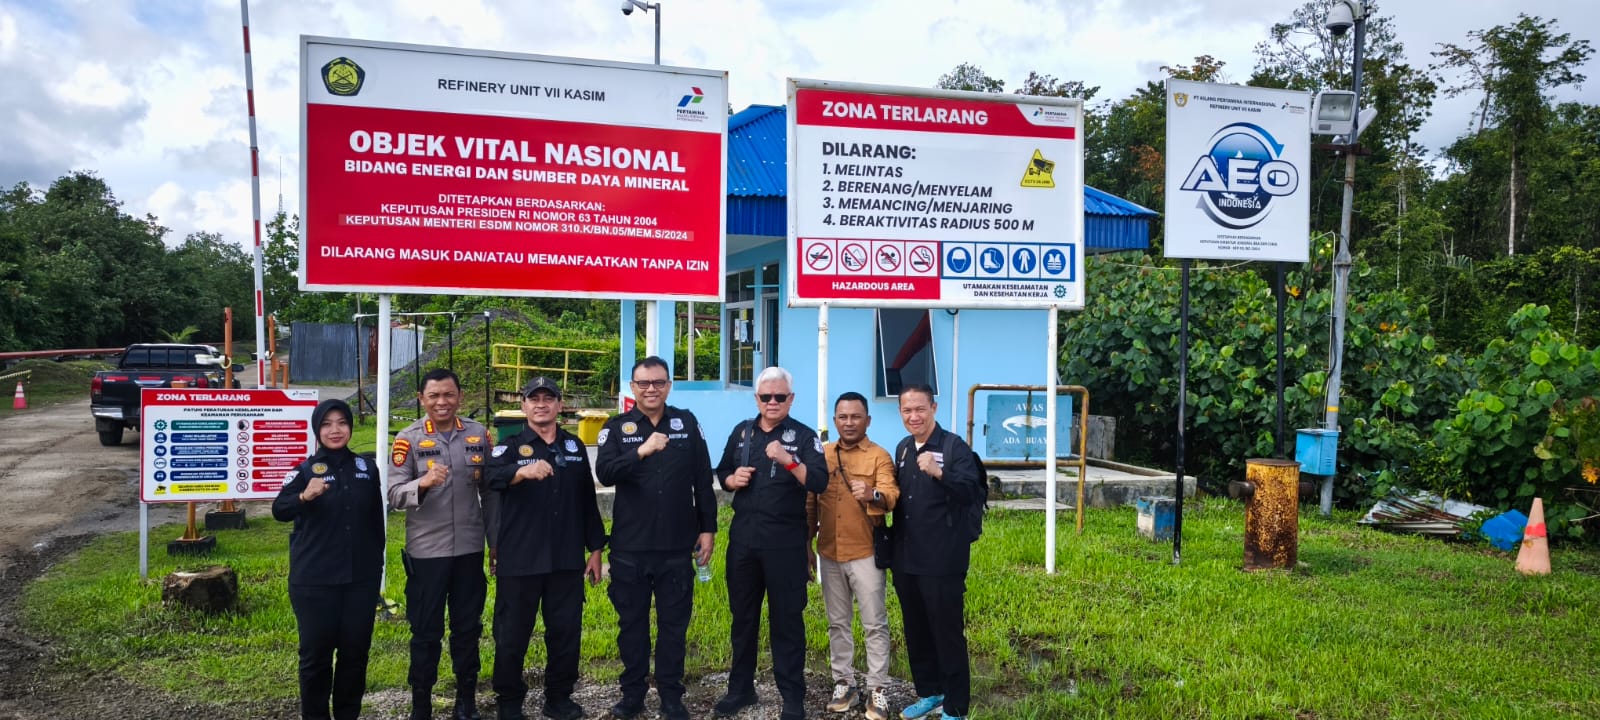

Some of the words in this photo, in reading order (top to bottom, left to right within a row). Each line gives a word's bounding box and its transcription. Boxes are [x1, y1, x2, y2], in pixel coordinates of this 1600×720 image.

[438, 78, 506, 94] REFINERY
[510, 84, 541, 96] UNIT
[544, 87, 560, 98] VII
[564, 89, 606, 102] KASIM
[822, 101, 877, 120] ZONA
[880, 104, 989, 126] TERLARANG
[349, 130, 447, 158] OBJEK
[455, 136, 537, 163] VITAL
[544, 142, 687, 173] NASIONAL
[822, 141, 917, 160] DILARANG:
[344, 159, 408, 175] BIDANG
[411, 163, 471, 178] ENERGI
[475, 167, 509, 181] DAN
[512, 169, 577, 185] SUMBER
[581, 173, 621, 187] DAYA
[624, 177, 690, 192] MINERAL
[822, 163, 832, 175] 1.
[834, 164, 903, 178] MELINTAS
[1180, 155, 1299, 197] AEO
[822, 179, 835, 192] 2.
[837, 180, 993, 198] BERENANG/MENYELAM
[438, 193, 513, 207] DITETAPKAN
[515, 197, 606, 212] BERDASARKAN:
[822, 197, 835, 209] 3.
[838, 198, 1013, 214] MEMANCING/MENJARING
[1218, 198, 1262, 209] INDONESIA
[381, 203, 454, 216] KEPUTUSAN
[457, 207, 516, 219] PRESIDEN
[518, 209, 531, 219] RI
[533, 211, 576, 222] NOMOR
[578, 213, 591, 223] 63
[593, 214, 632, 225] TAHUN
[633, 216, 658, 226] 2004
[822, 213, 836, 226] 4.
[839, 214, 938, 229] BERAKTIVITAS
[940, 218, 991, 230] RADIUS
[994, 219, 1020, 231] 500
[1022, 220, 1035, 231] M
[345, 215, 420, 227] KEPUTUSAN
[423, 217, 476, 229] MENTERI
[479, 219, 513, 231] ESDM
[515, 221, 559, 232] NOMOR
[561, 223, 688, 241] 310.K/BN.05/MEM.S/2024
[320, 245, 396, 259] DILARANG
[399, 248, 450, 262] MASUK
[453, 250, 524, 264] DAN/ATAU
[527, 253, 639, 269] MEMANFAATKAN
[641, 257, 683, 270] TANPA
[686, 260, 709, 272] IZIN
[832, 281, 890, 291] HAZARDOUS
[890, 282, 915, 291] AREA
[157, 393, 187, 401] ZONA
[189, 393, 251, 401] TERLARANG
[1025, 436, 1048, 444] BUAY
